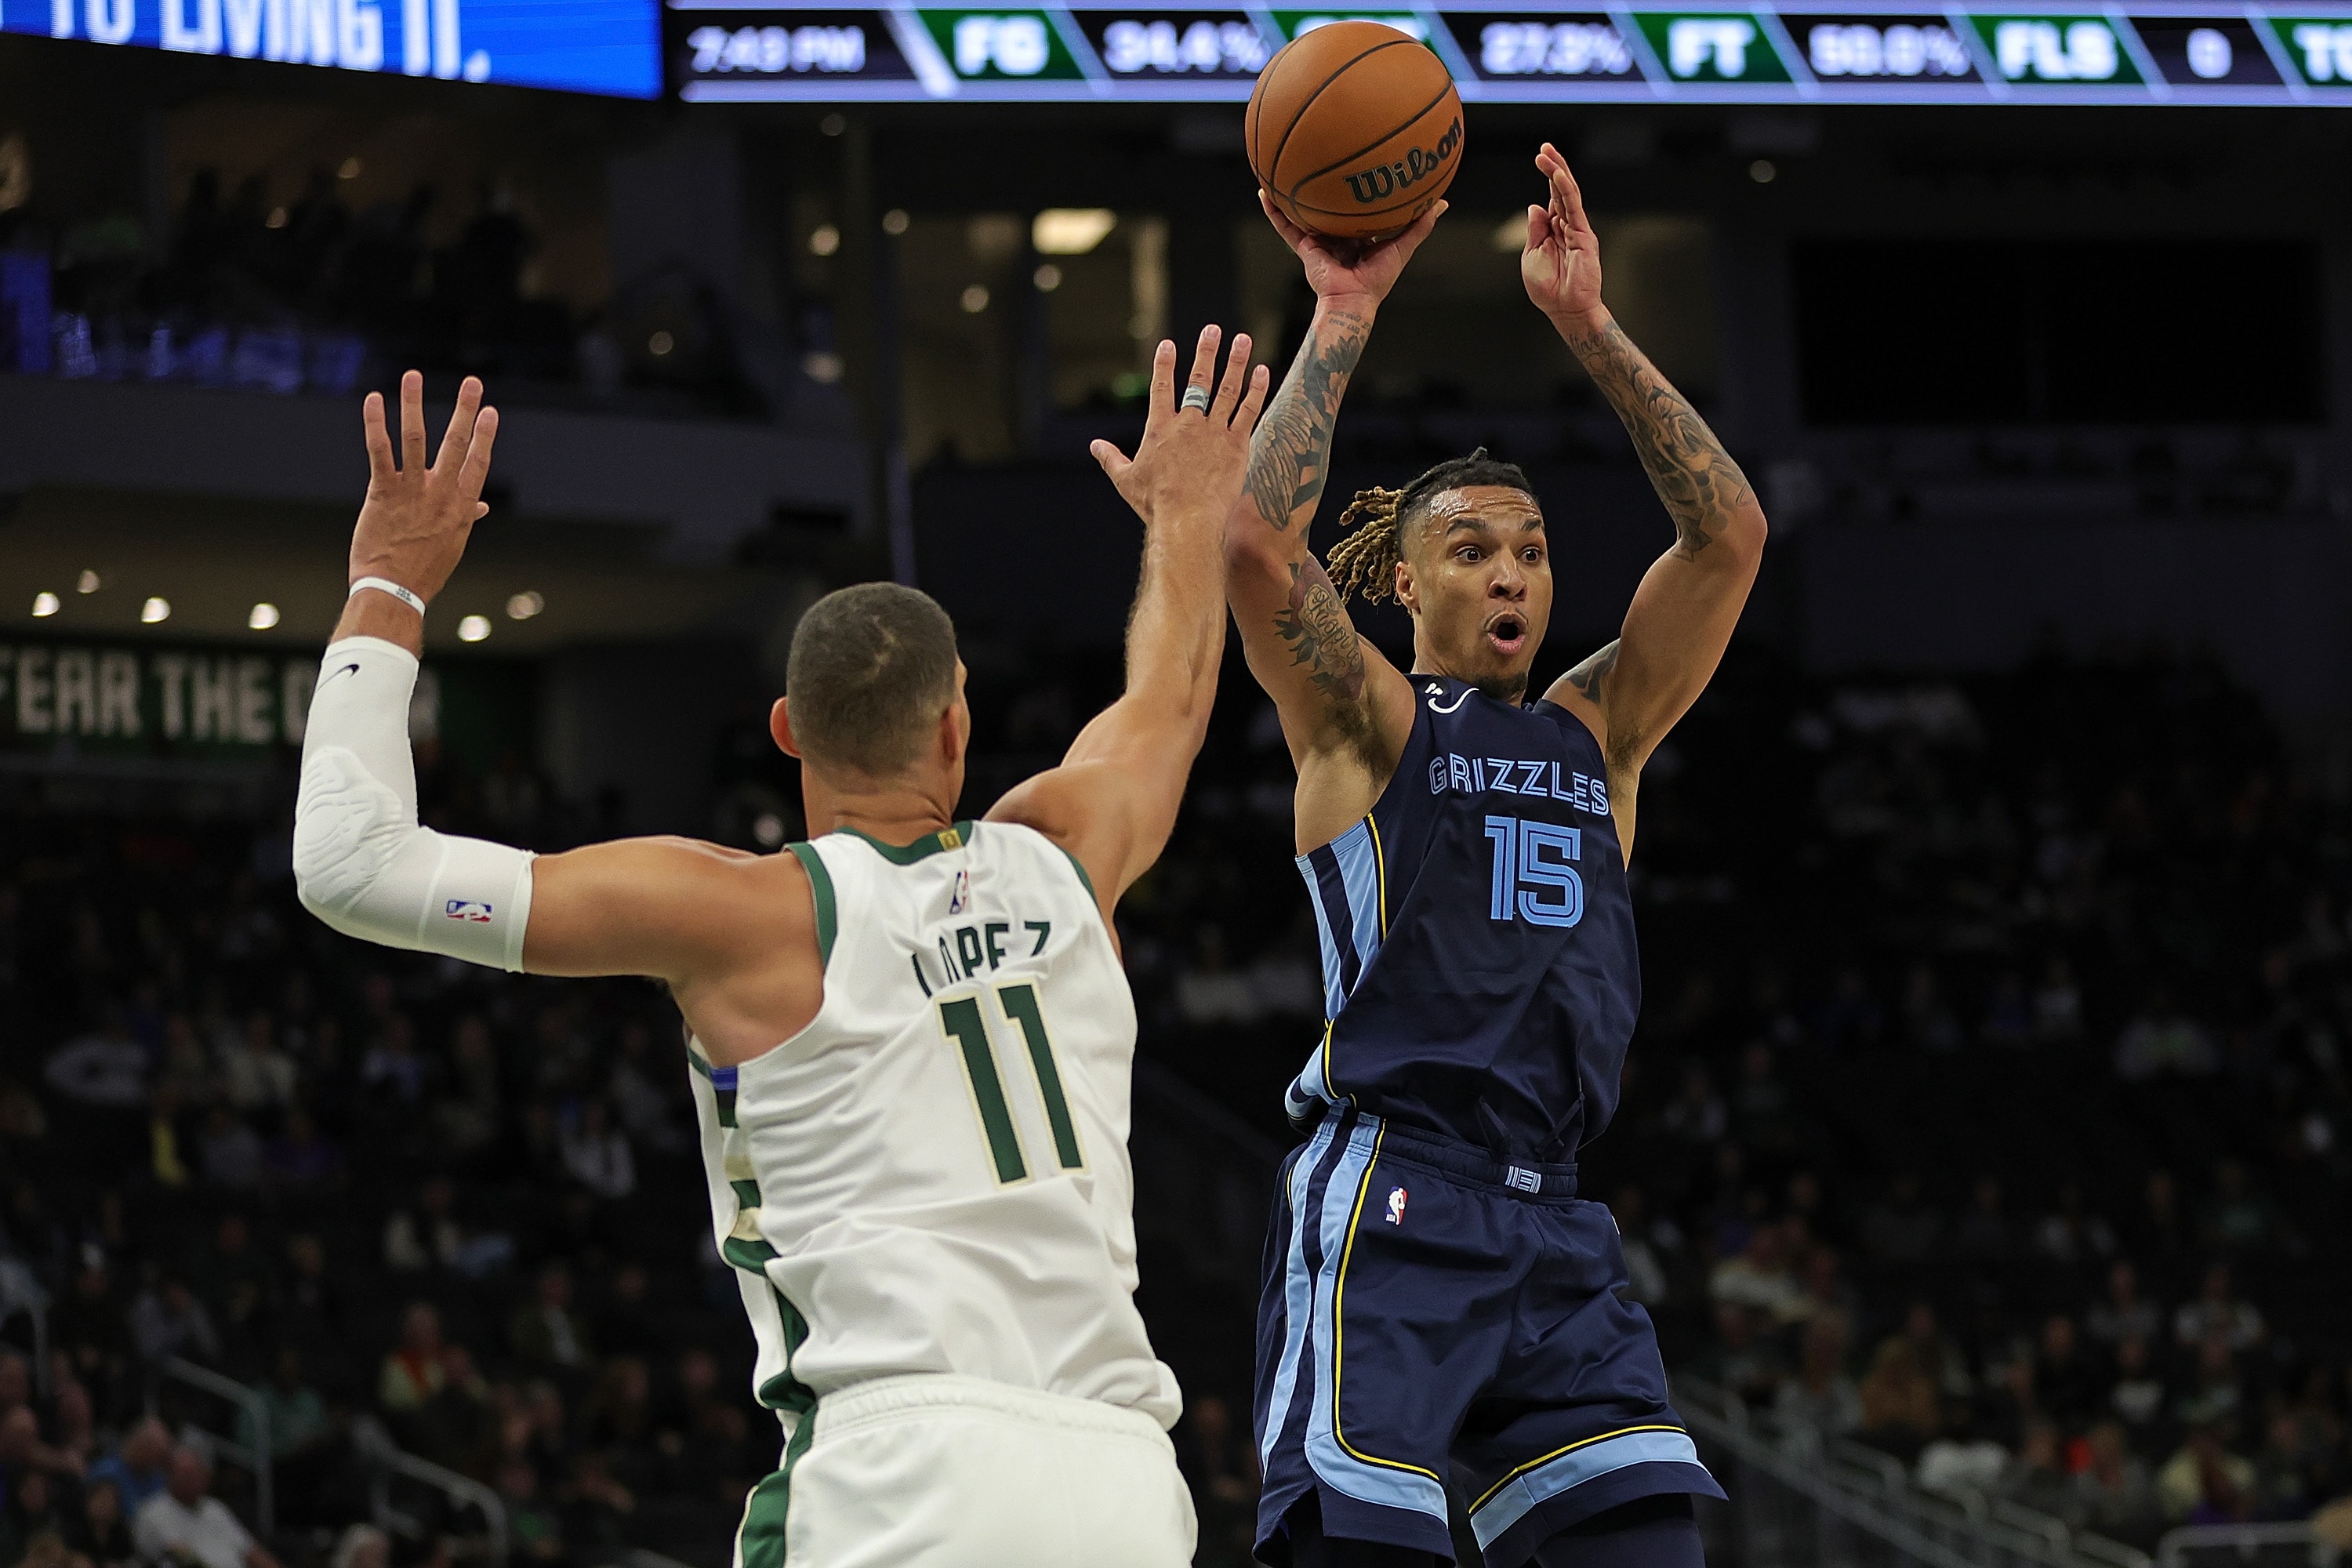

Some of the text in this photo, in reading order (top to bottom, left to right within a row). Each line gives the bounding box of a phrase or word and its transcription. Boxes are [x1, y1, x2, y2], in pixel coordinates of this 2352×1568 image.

[790, 25, 866, 72] PM
[953, 16, 1048, 74] FG
[1668, 20, 1756, 77] FT
[1994, 22, 2118, 78] FLS
[1344, 116, 1461, 204] Wilson
[155, 651, 276, 745] THE
[1485, 815, 1584, 927] 15
[937, 980, 1086, 1186] 11
